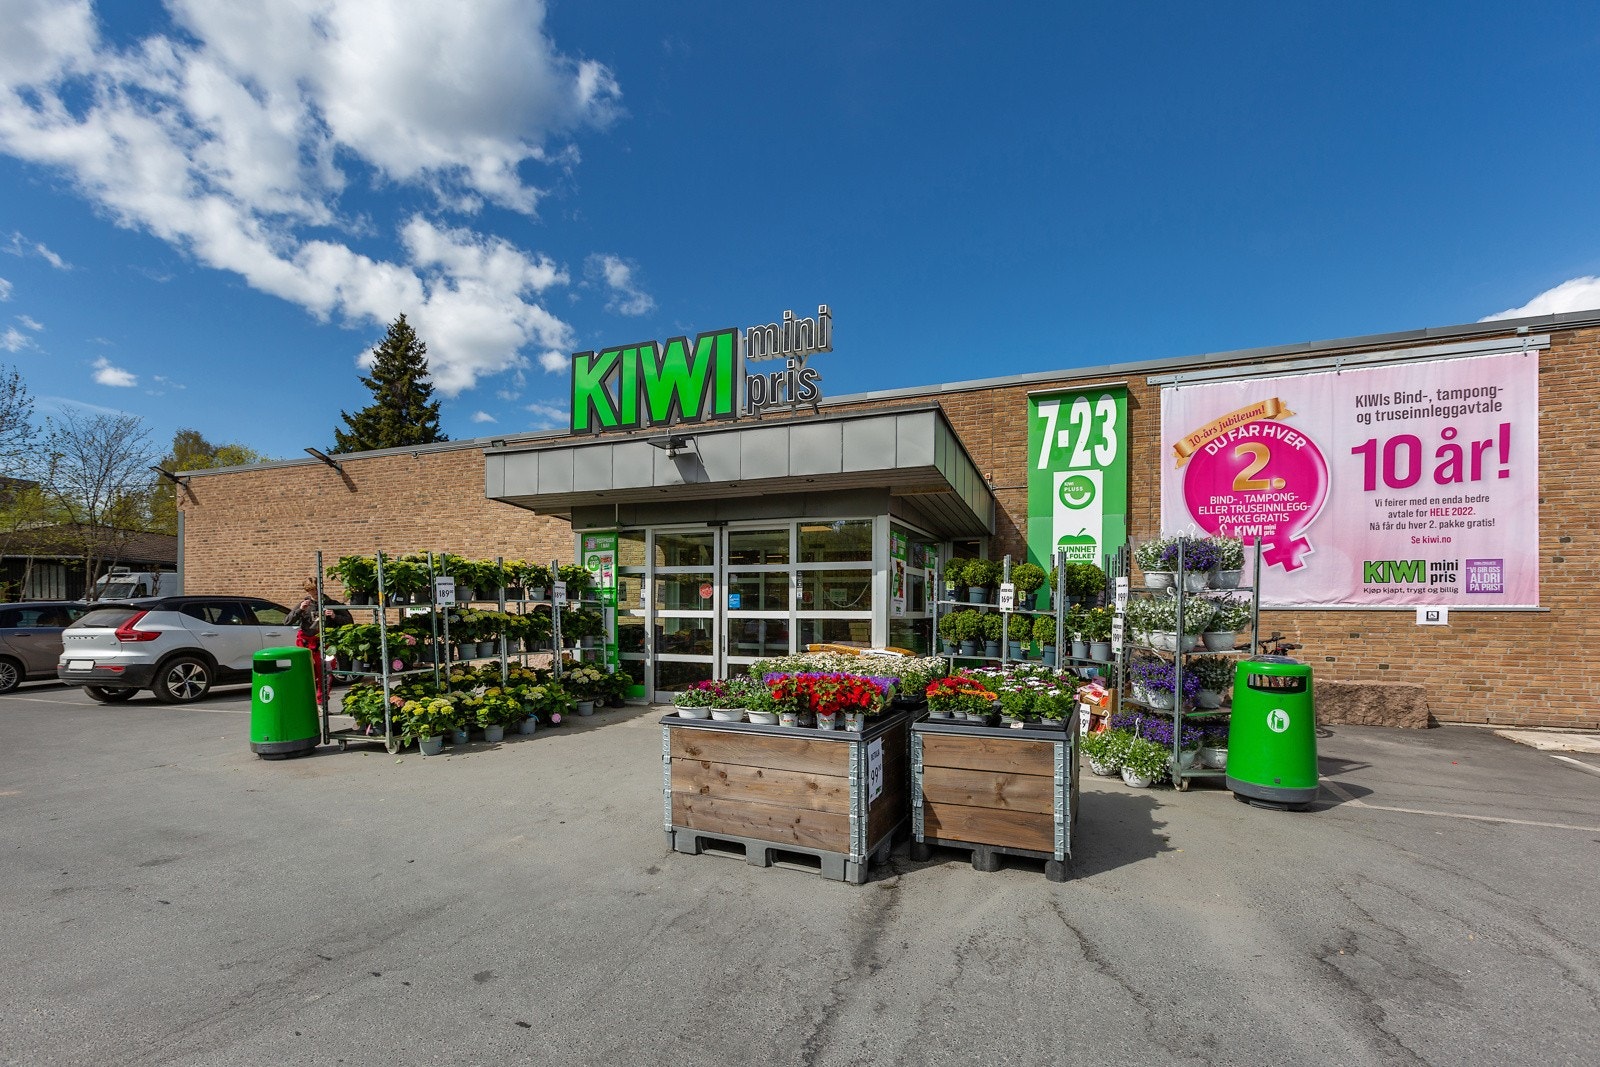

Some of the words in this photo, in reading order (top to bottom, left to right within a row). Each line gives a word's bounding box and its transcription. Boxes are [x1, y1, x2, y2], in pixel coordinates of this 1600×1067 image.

[746, 304, 832, 358] mini
[570, 327, 741, 435] KIWI
[746, 359, 820, 416] pris
[1355, 393, 1391, 408] KIWIs
[1394, 389, 1432, 405] Bind-,
[1436, 385, 1504, 403] tampong-
[1356, 411, 1372, 425] og
[1375, 399, 1503, 422] truseinnleggavtale
[1037, 393, 1118, 470] 7-23
[1189, 426, 1218, 447] 10-års
[1219, 405, 1266, 432] jubileum!
[1204, 435, 1228, 456] DU
[1262, 424, 1307, 451] HVER
[1351, 434, 1422, 492] 10
[1433, 422, 1511, 486] år!
[1232, 441, 1287, 492] 2.
[1244, 492, 1299, 503] TAMPONG-
[1374, 498, 1384, 507] Vi
[1384, 497, 1407, 507] feirer
[1409, 496, 1428, 506] med
[1429, 497, 1440, 505] en
[1441, 495, 1463, 505] enda
[1464, 494, 1490, 504] bedre
[1198, 506, 1228, 515] ELLER
[1229, 502, 1312, 514] TRUSEINNLEGG-
[1388, 508, 1414, 519] avtale
[1415, 507, 1428, 518] for
[1430, 507, 1450, 517] HELE
[1451, 506, 1476, 517] 2022.
[1218, 514, 1252, 524] PAKKE
[1253, 512, 1290, 523] GRATIS
[1369, 520, 1381, 531] Nå
[1382, 520, 1394, 531] får
[1395, 520, 1406, 530] du
[1408, 520, 1427, 530] hver
[1428, 519, 1437, 529] 2.
[1439, 519, 1465, 530] pakke
[1466, 518, 1496, 530] gratis!
[1234, 524, 1263, 537] KIWI
[1411, 535, 1421, 545] Se
[1422, 534, 1452, 544] kiwi.no
[1057, 545, 1098, 553] SUNNHET
[1363, 559, 1427, 584] KIWI
[1430, 559, 1459, 571] mini
[1430, 571, 1456, 586] pris
[1470, 572, 1501, 584] ALDRI
[1363, 587, 1382, 595] Kjøp
[1382, 586, 1406, 595] kjapt,
[1406, 586, 1426, 595] trygt
[1427, 587, 1439, 595] og
[1439, 586, 1459, 595] billig
